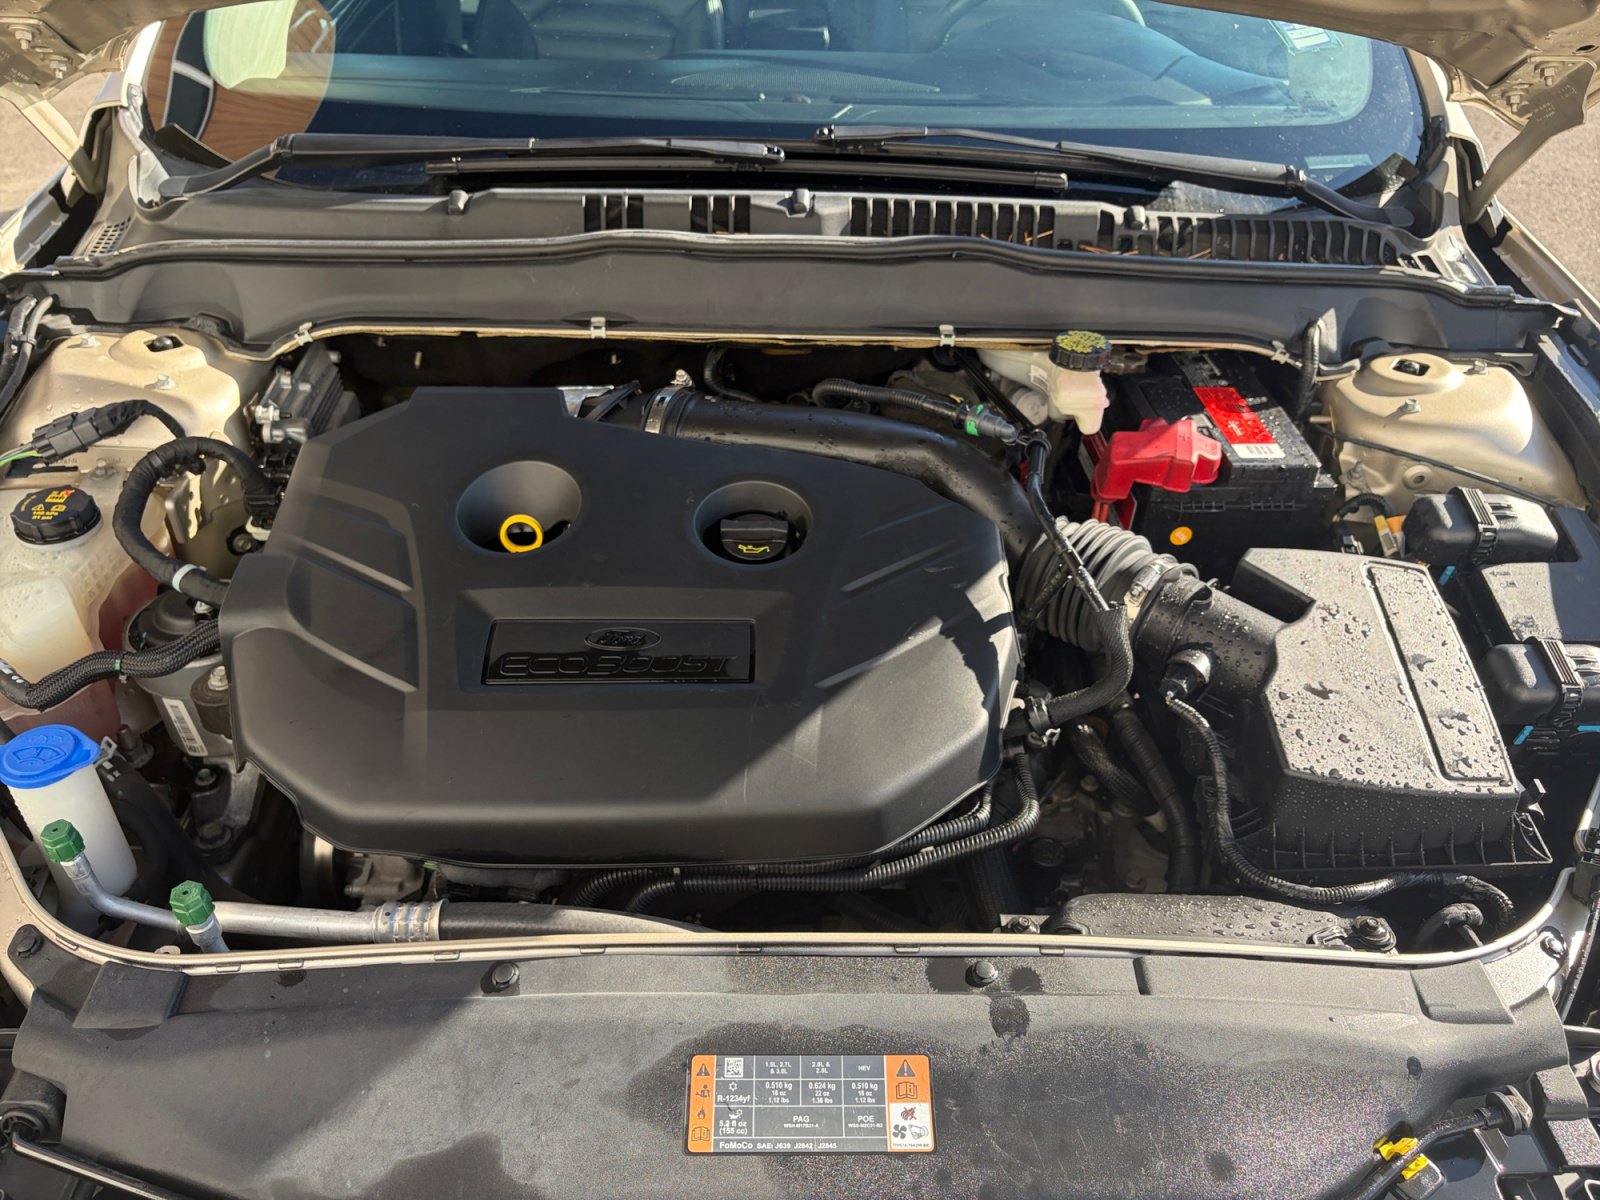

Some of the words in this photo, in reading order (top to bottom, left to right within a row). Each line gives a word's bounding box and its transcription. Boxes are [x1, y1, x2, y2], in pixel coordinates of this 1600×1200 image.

[597, 629, 646, 647] Ford
[765, 1081, 782, 1089] 0.510
[784, 1081, 793, 1091] kg
[808, 1082, 826, 1090] 0.624
[827, 1082, 836, 1091] kg
[851, 1082, 869, 1090] 0.510
[869, 1082, 878, 1091] kg
[717, 1095, 751, 1104] R-1234yf
[792, 1115, 810, 1123] PAG
[719, 1127, 735, 1135] (155
[736, 1127, 748, 1135] cc)
[719, 1141, 753, 1149] FoMoCo
